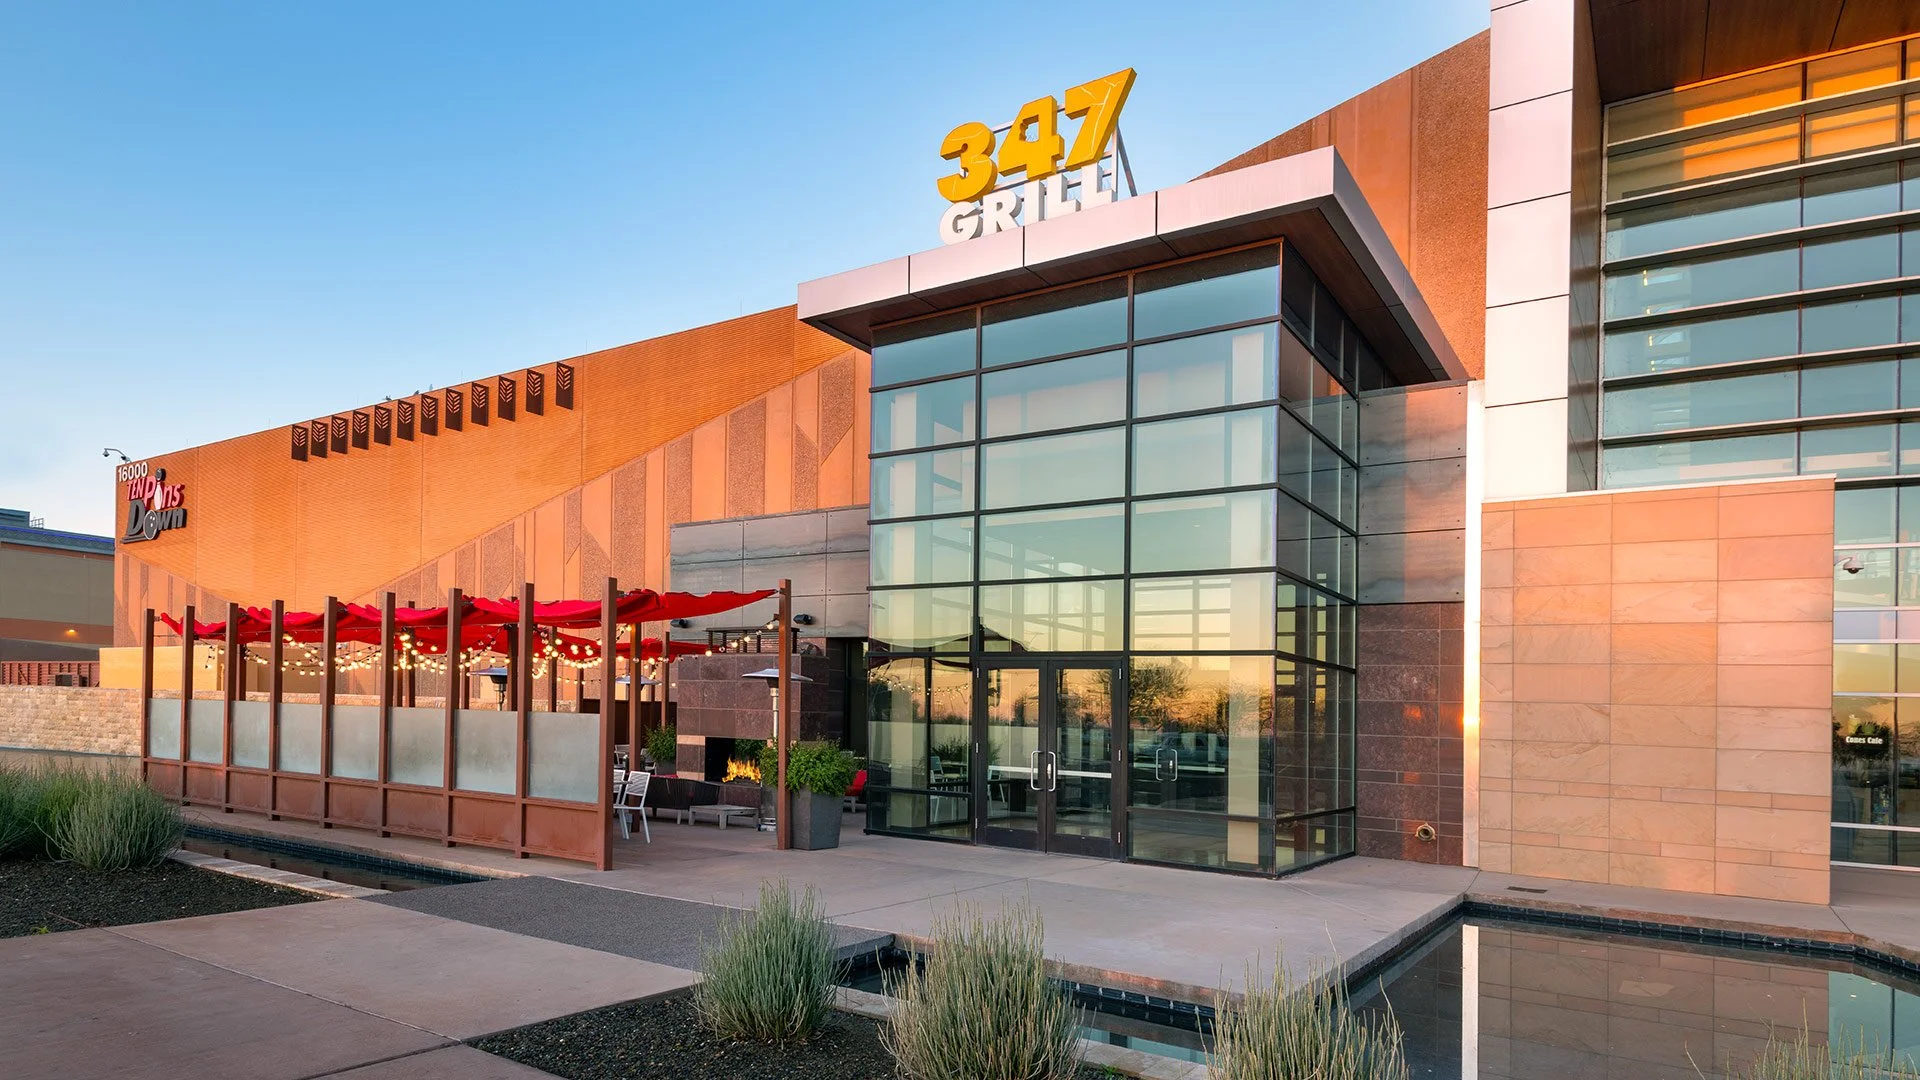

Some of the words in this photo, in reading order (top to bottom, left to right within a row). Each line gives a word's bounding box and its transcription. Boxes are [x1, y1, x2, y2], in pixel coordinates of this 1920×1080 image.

[937, 67, 1137, 204] 347
[939, 162, 1116, 246] GRILL
[118, 461, 149, 482] 16000
[127, 478, 146, 501] TEN
[121, 499, 186, 543] Down
[1867, 737, 1884, 745] Cafe
